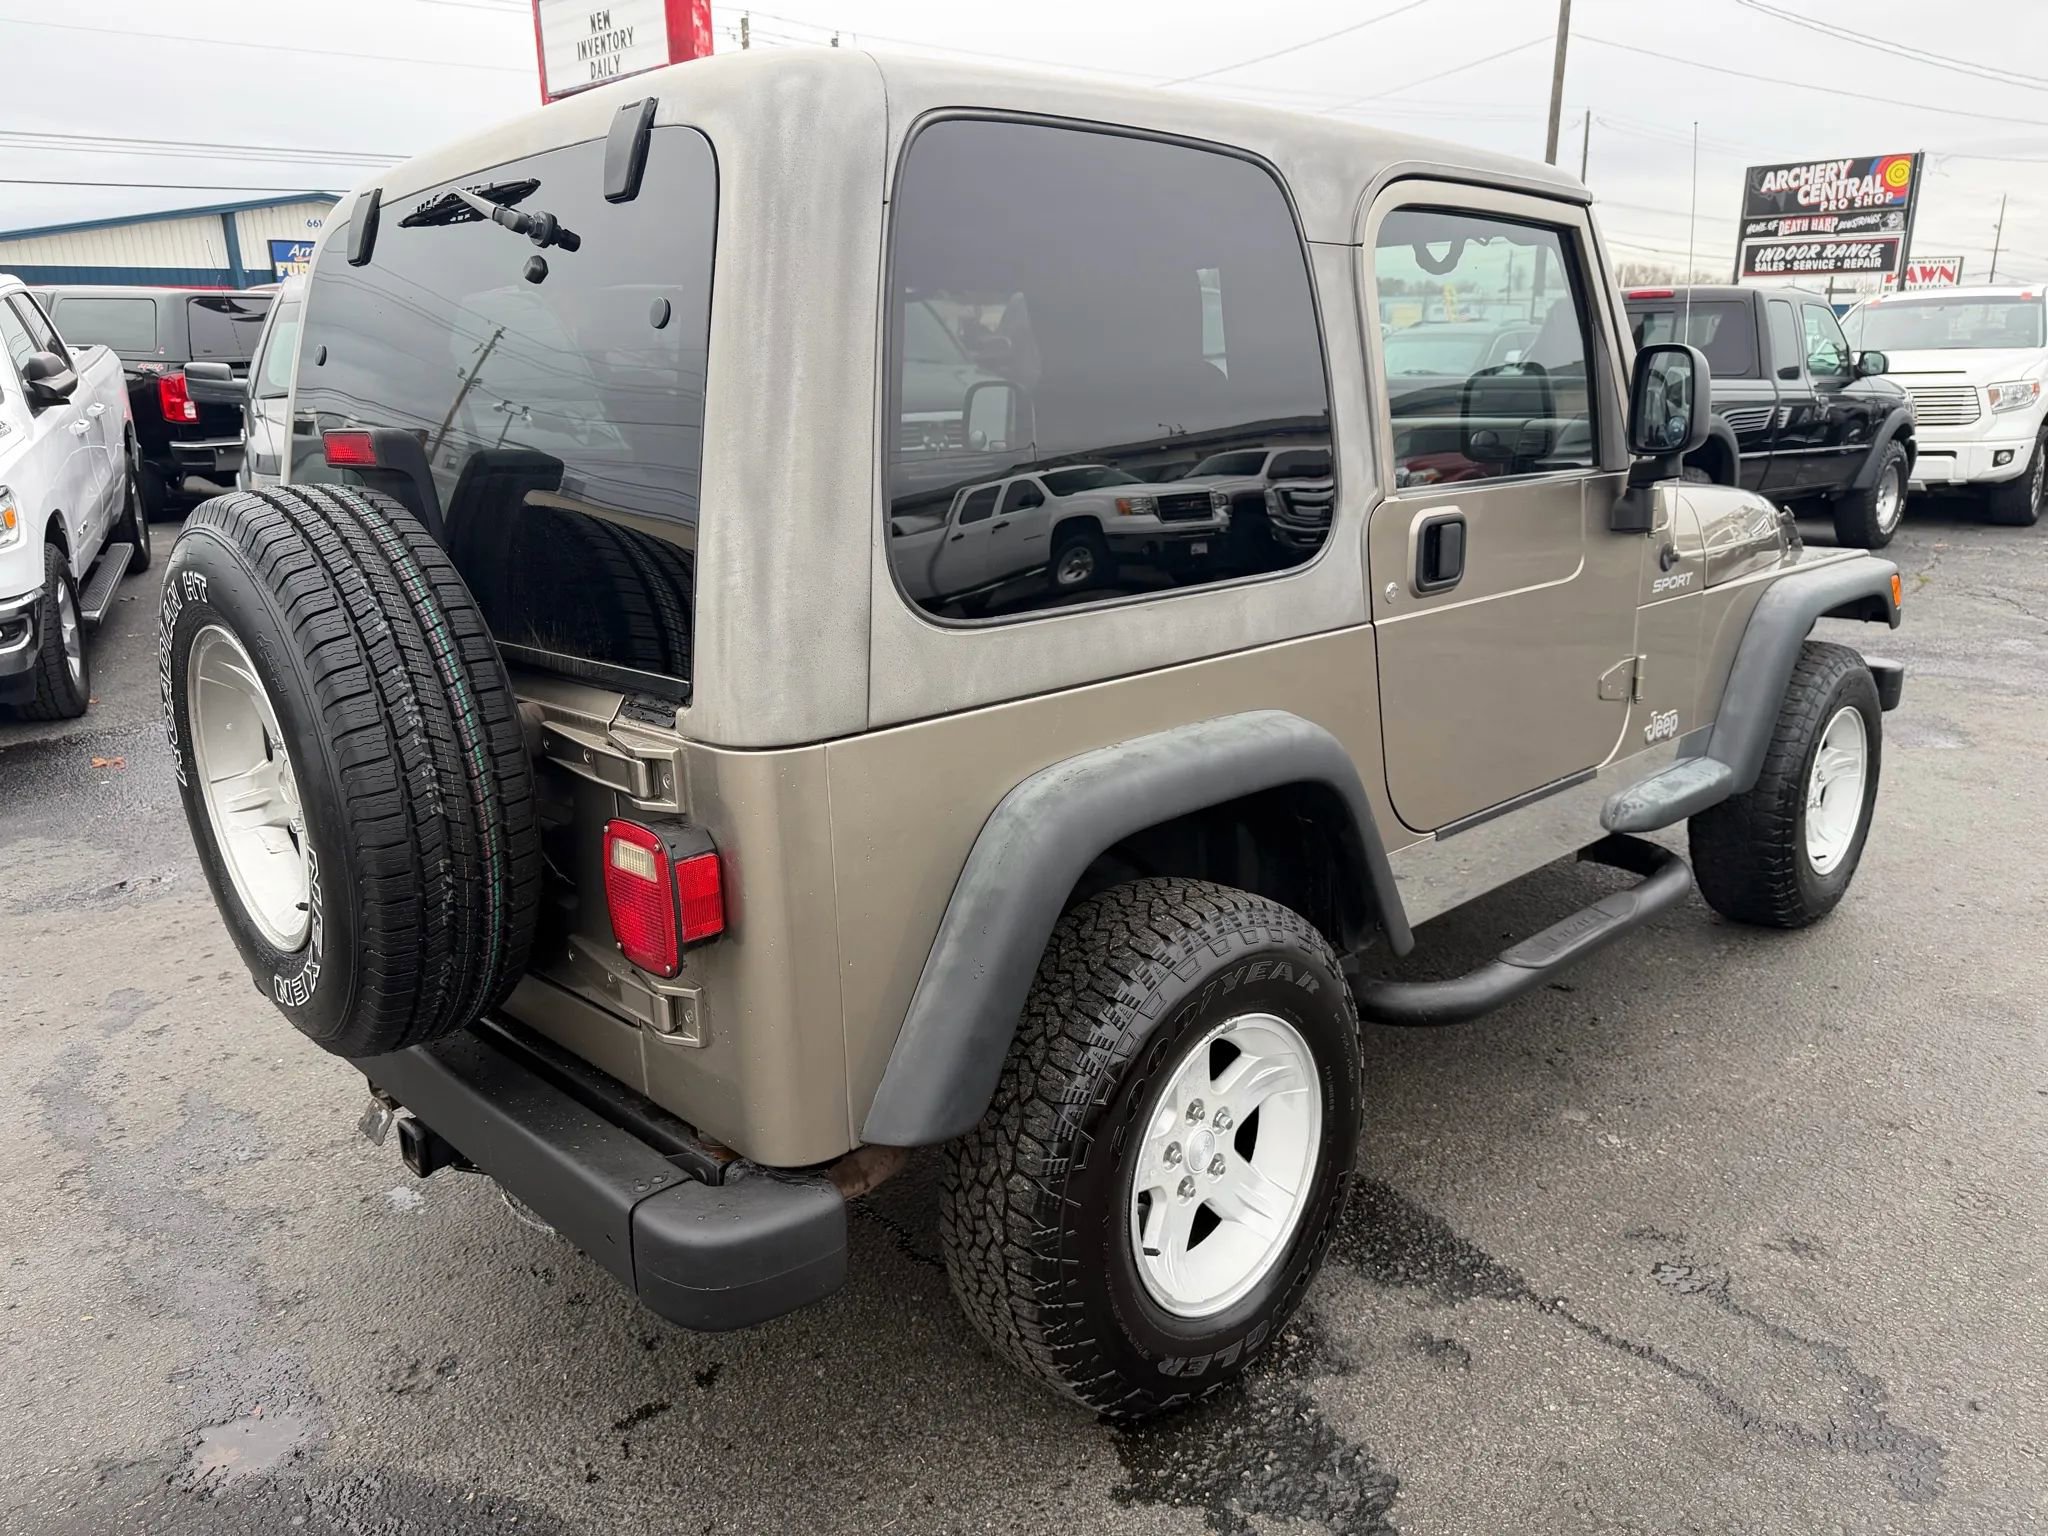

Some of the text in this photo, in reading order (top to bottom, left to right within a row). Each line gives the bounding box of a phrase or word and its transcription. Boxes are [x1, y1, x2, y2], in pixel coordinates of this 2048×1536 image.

[590, 9, 611, 35] NEW
[577, 26, 634, 61] INVENTORY
[590, 54, 621, 80] DAILY
[1760, 159, 1853, 193] ARCHERY
[1797, 173, 1885, 207] CENTRAL
[1820, 191, 1894, 212] PRO SHOP
[1767, 219, 1779, 231] OF
[1777, 218, 1809, 237] DEATH
[1754, 257, 1882, 272] SALES SERVICE REPAIR
[1755, 243, 1885, 262] INDOOR RANGE
[182, 570, 208, 604] HT
[1652, 571, 1694, 593] SPORT
[1644, 708, 1679, 745] Jeep
[1110, 959, 1321, 1173] GOODYEAR
